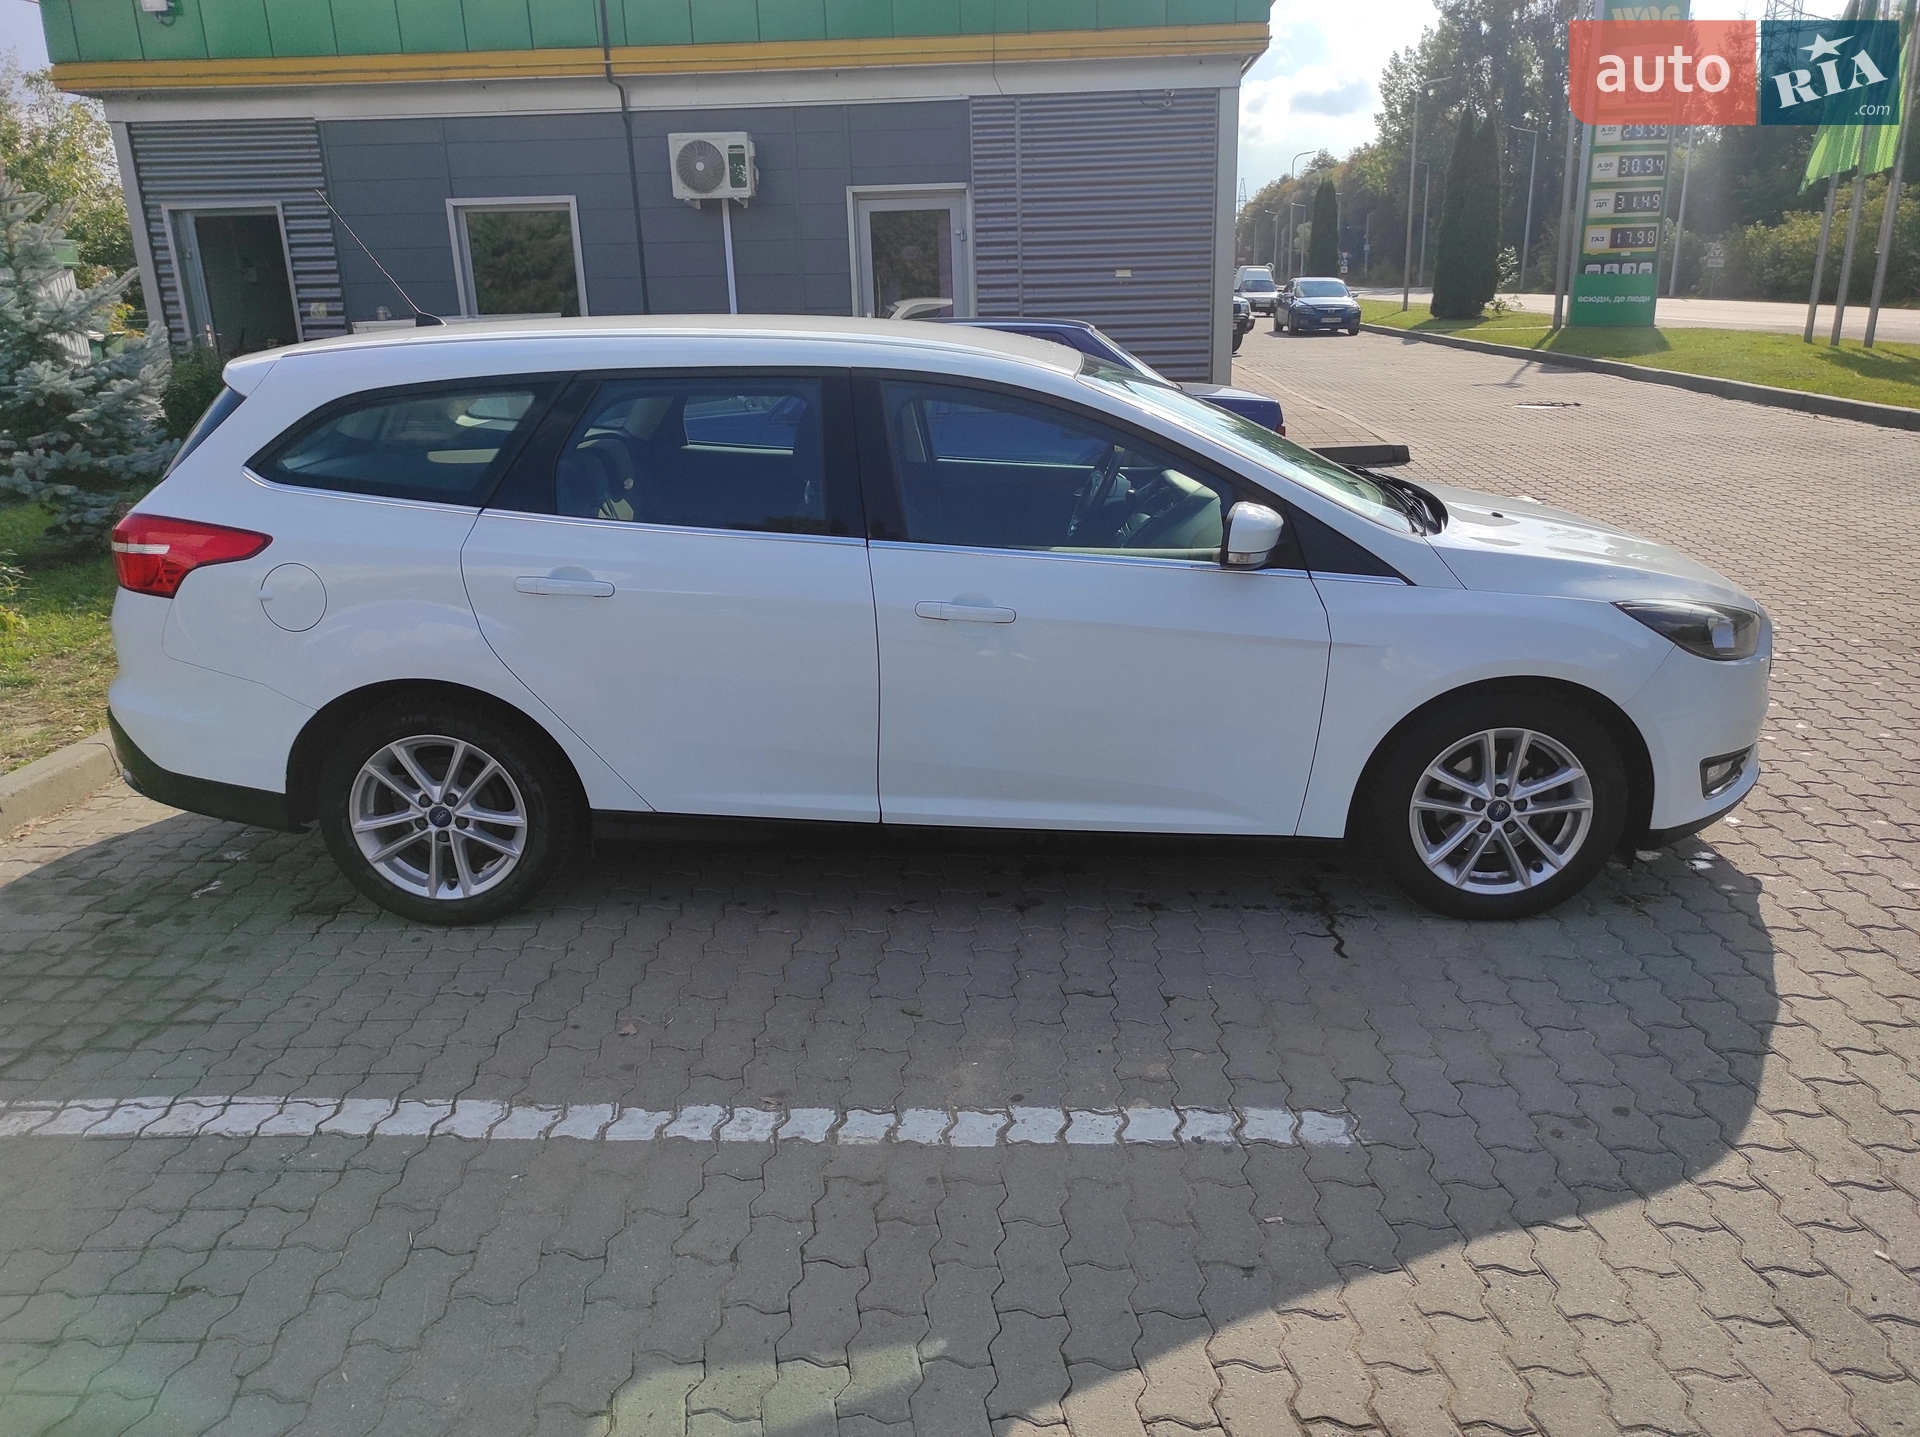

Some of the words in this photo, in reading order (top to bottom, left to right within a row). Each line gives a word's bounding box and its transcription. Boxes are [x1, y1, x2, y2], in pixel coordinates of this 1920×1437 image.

[1611, 5, 1680, 29] WOG
[1621, 158, 1664, 174] 30.94
[1617, 194, 1660, 210] 31.49
[1617, 230, 1655, 244] 17.98
[1577, 295, 1612, 304] всюди,
[1613, 295, 1626, 304] де
[1626, 295, 1651, 304] люди
